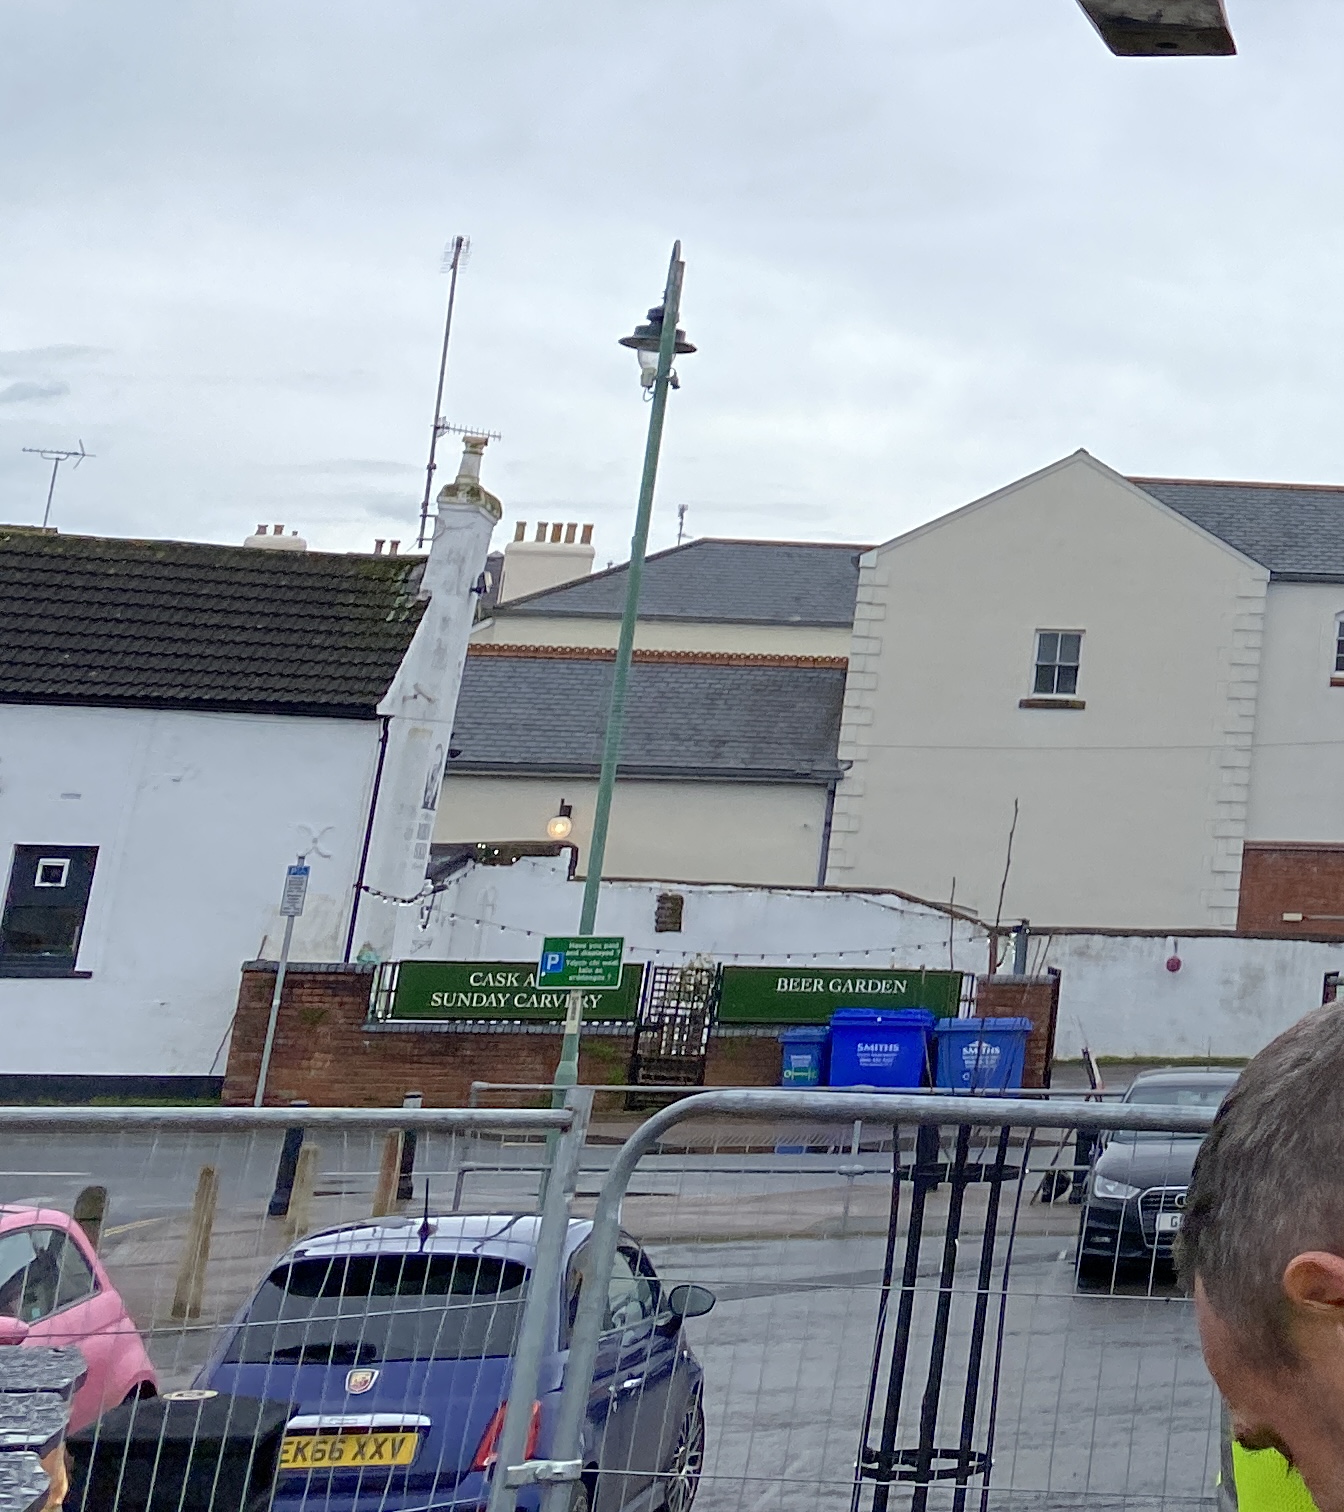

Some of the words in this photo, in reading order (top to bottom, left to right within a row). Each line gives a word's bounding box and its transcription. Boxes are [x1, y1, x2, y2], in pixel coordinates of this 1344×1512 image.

[469, 972, 520, 987] CASK
[777, 977, 824, 992] BEER
[829, 978, 907, 994] GARDEN
[431, 992, 510, 1007] SUNDAY
[962, 1046, 1001, 1055] SMTHS
[280, 1440, 345, 1464] EK66
[351, 1437, 406, 1461] XXV
